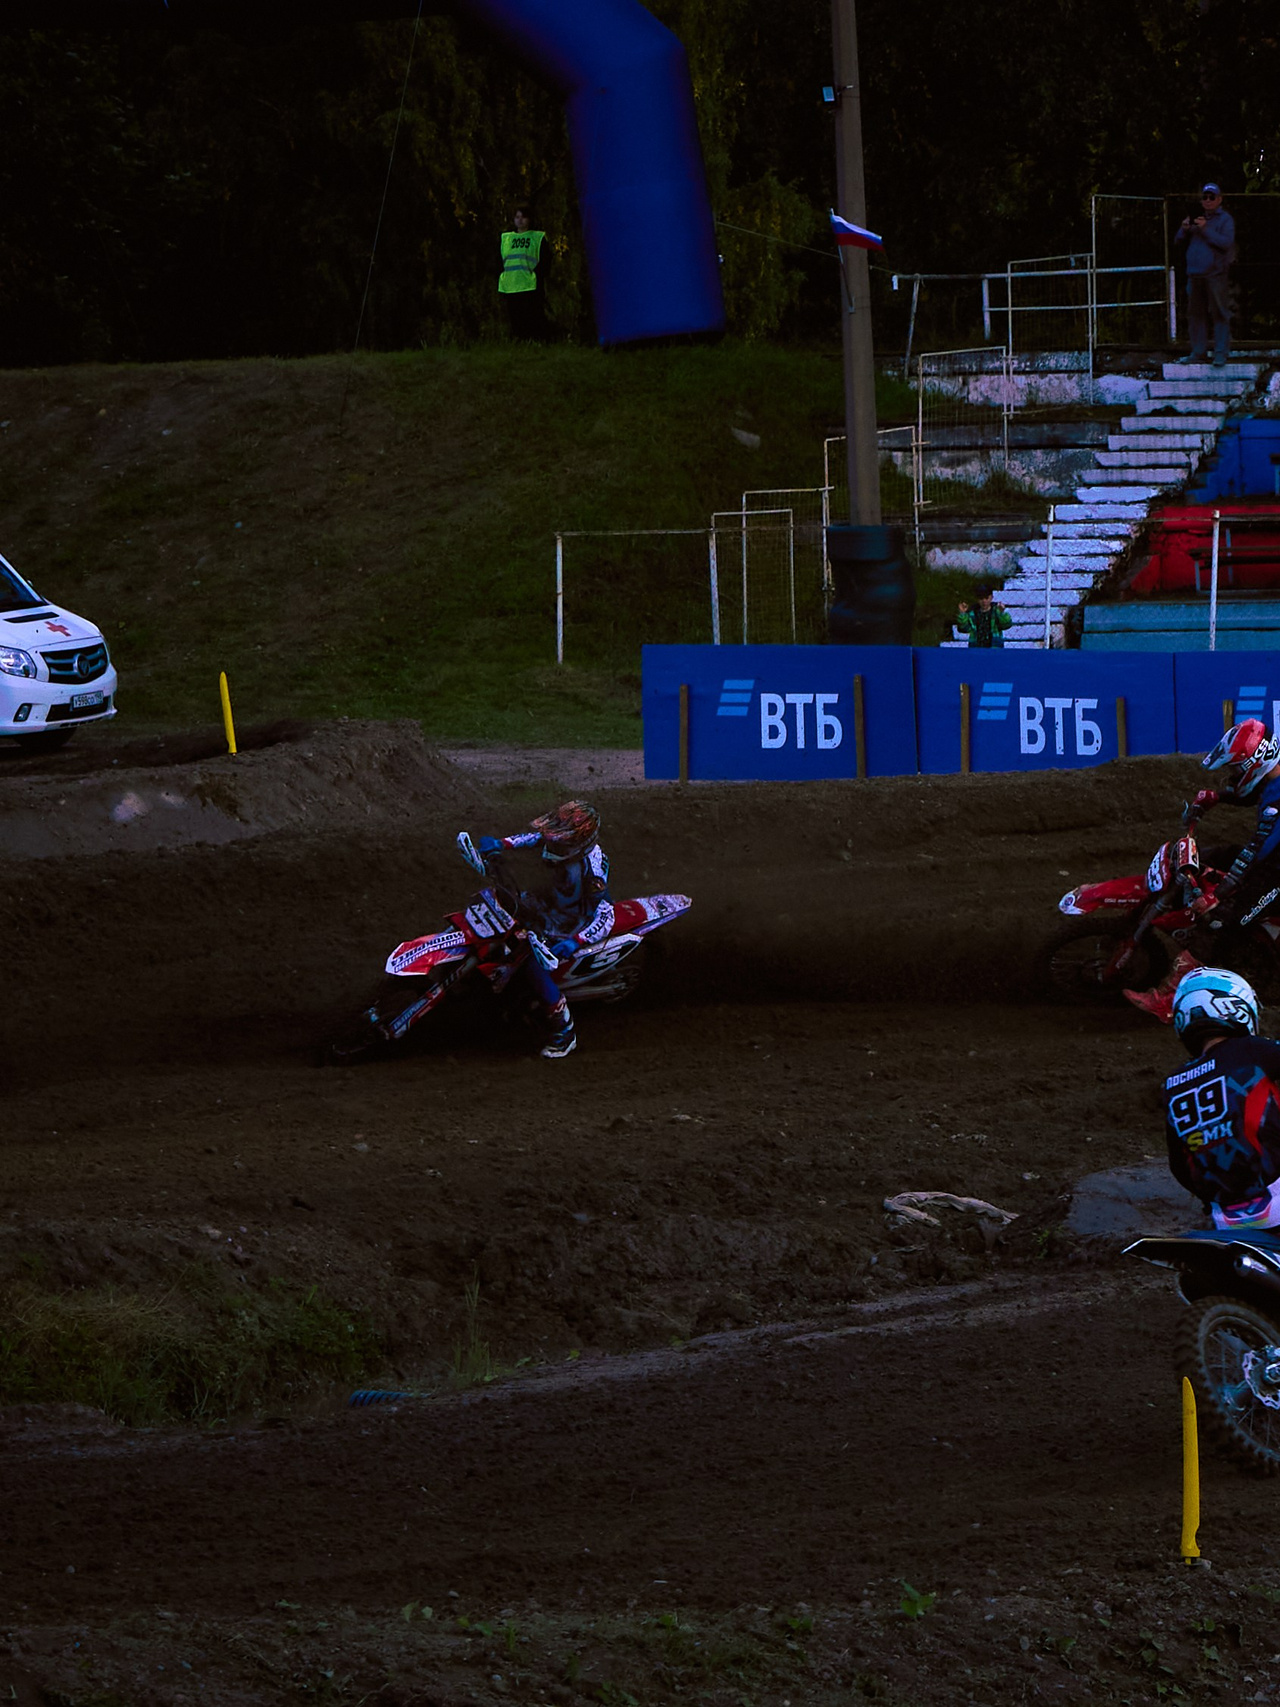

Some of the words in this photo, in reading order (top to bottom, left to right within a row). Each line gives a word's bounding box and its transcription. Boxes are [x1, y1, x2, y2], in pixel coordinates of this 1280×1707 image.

[511, 237, 530, 249] 2095
[760, 693, 843, 749] ВТБ
[1019, 697, 1103, 755] ВТБ
[591, 948, 619, 969] 5
[1168, 1075, 1229, 1137] 99
